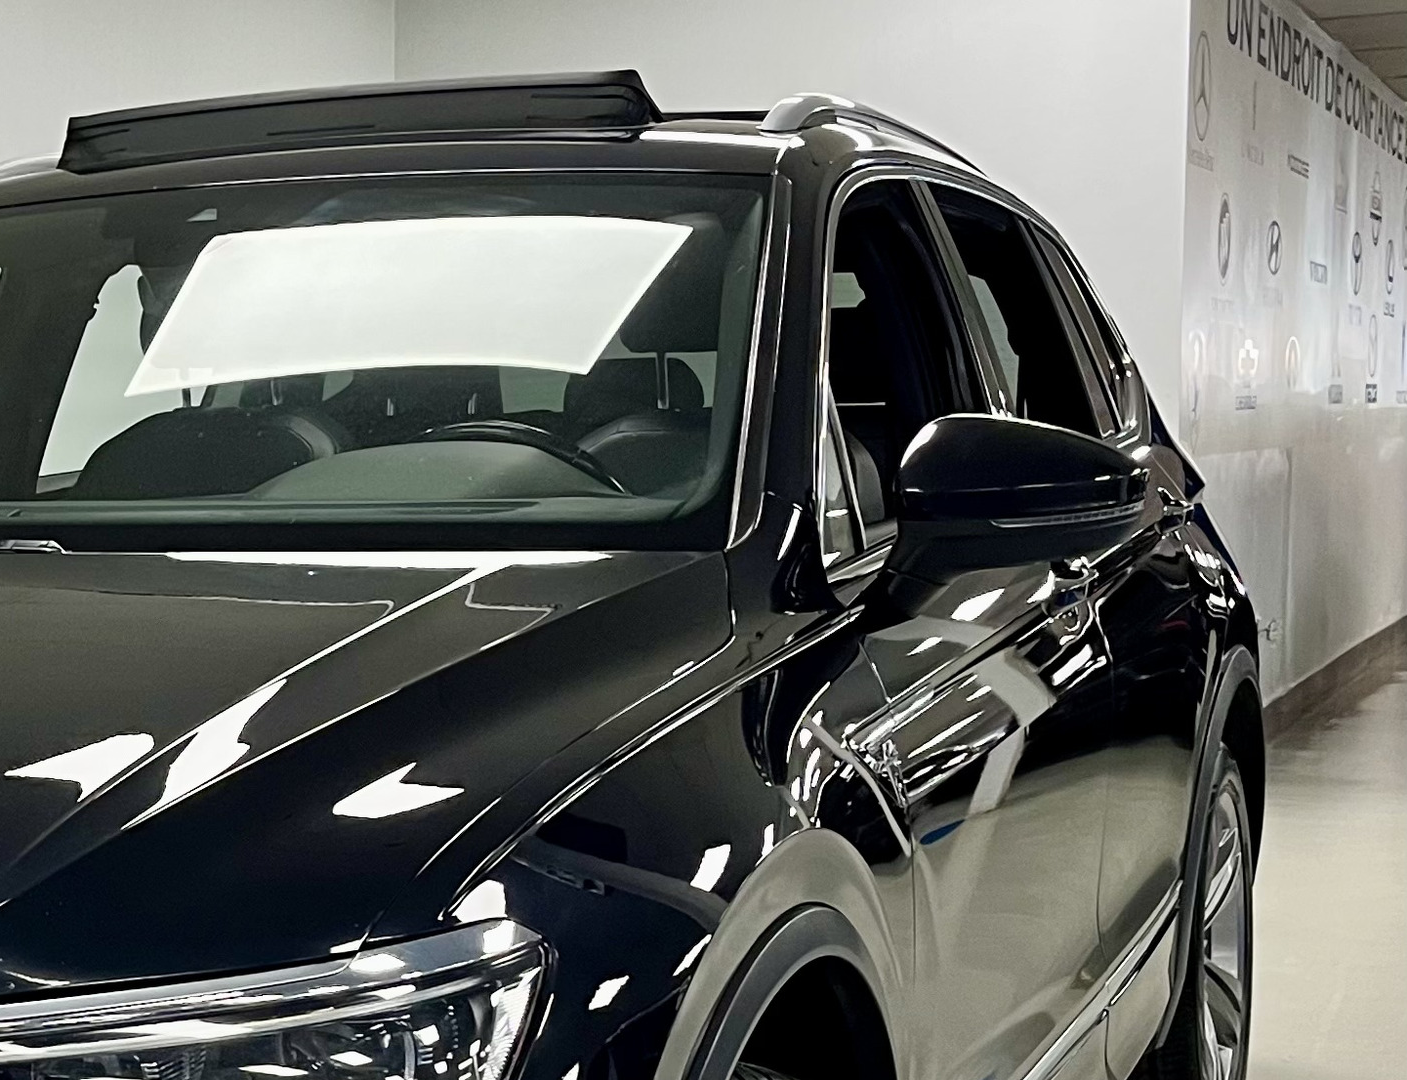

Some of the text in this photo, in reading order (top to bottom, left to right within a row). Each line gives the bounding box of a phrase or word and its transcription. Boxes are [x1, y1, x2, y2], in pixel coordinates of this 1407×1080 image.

[1227, 0, 1404, 161] UN ENDROIT DE CONFIANCE
